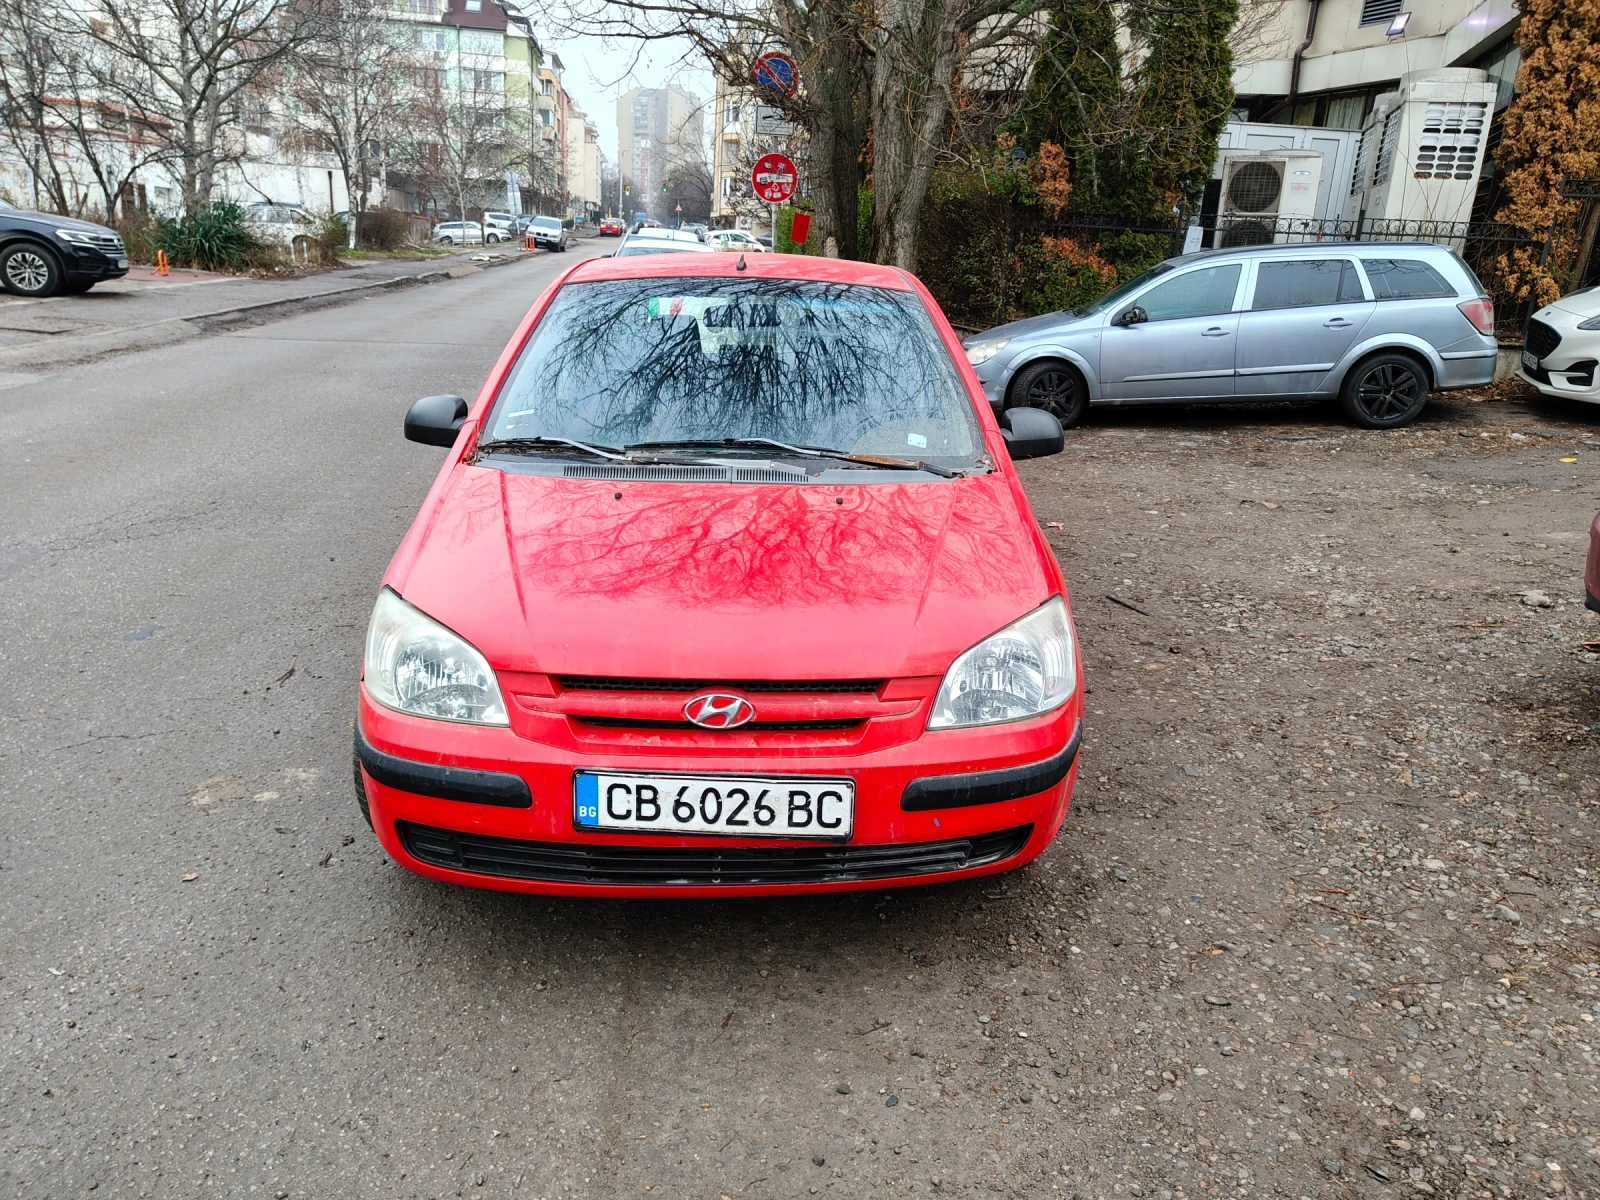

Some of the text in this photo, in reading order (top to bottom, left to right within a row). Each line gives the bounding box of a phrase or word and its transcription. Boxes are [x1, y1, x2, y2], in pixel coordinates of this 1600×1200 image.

[579, 805, 597, 818] BG
[606, 783, 843, 829] CB 6026 BC
